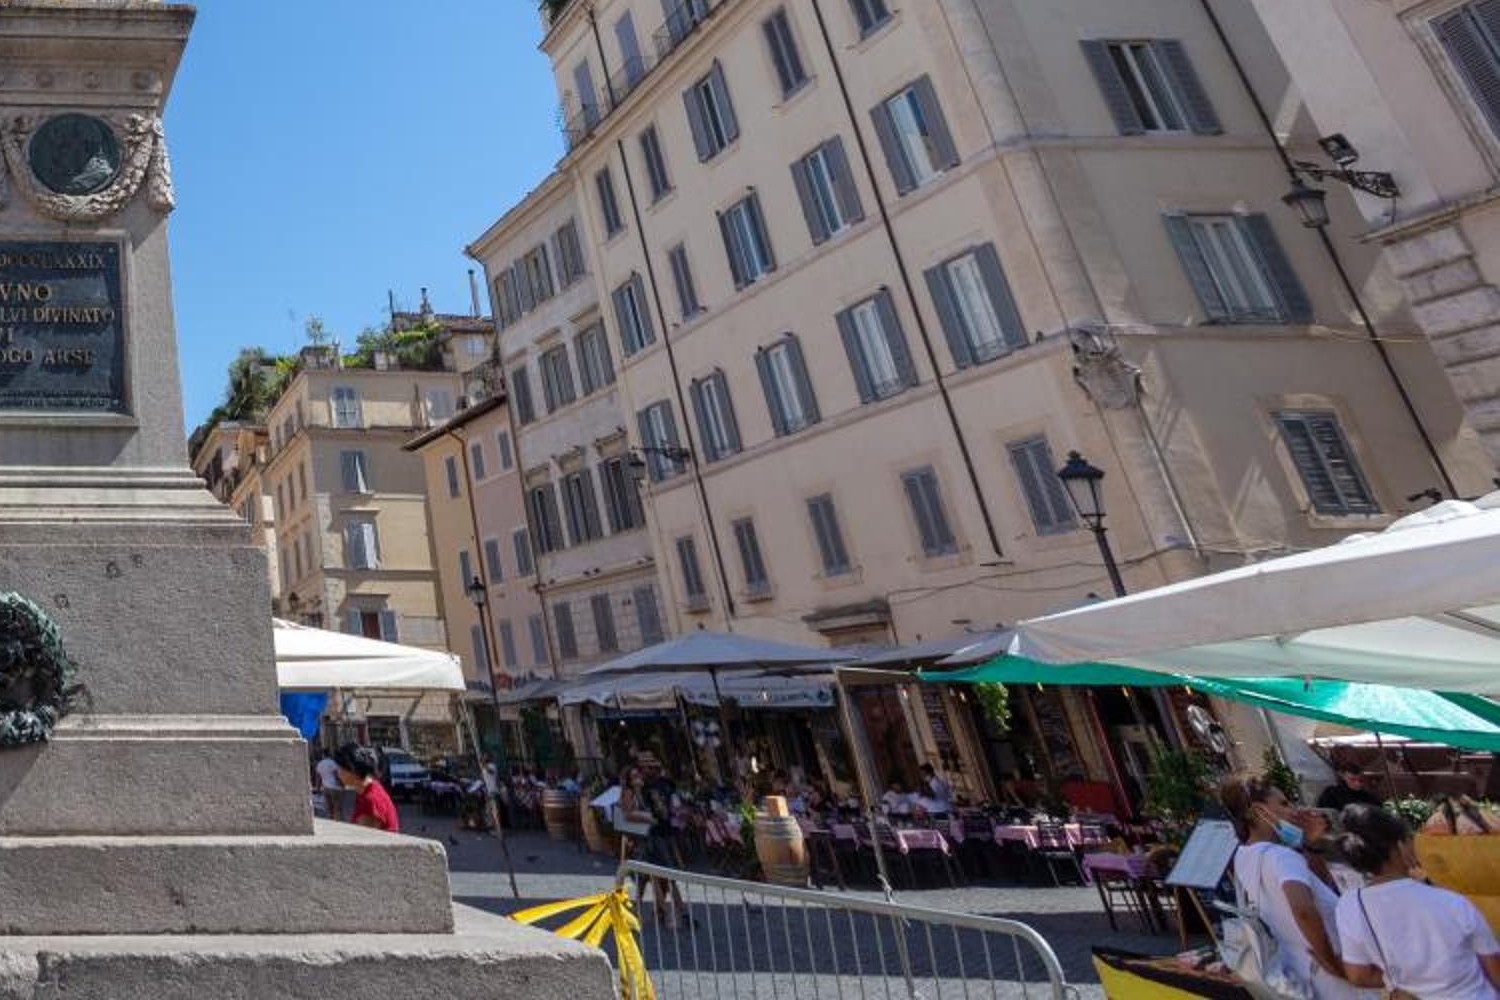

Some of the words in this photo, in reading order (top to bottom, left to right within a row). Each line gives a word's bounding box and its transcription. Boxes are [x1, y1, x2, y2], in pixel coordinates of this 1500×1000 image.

[0, 307, 28, 322] LVI
[33, 307, 116, 323] DIVINATO
[42, 348, 97, 365] ARSE
